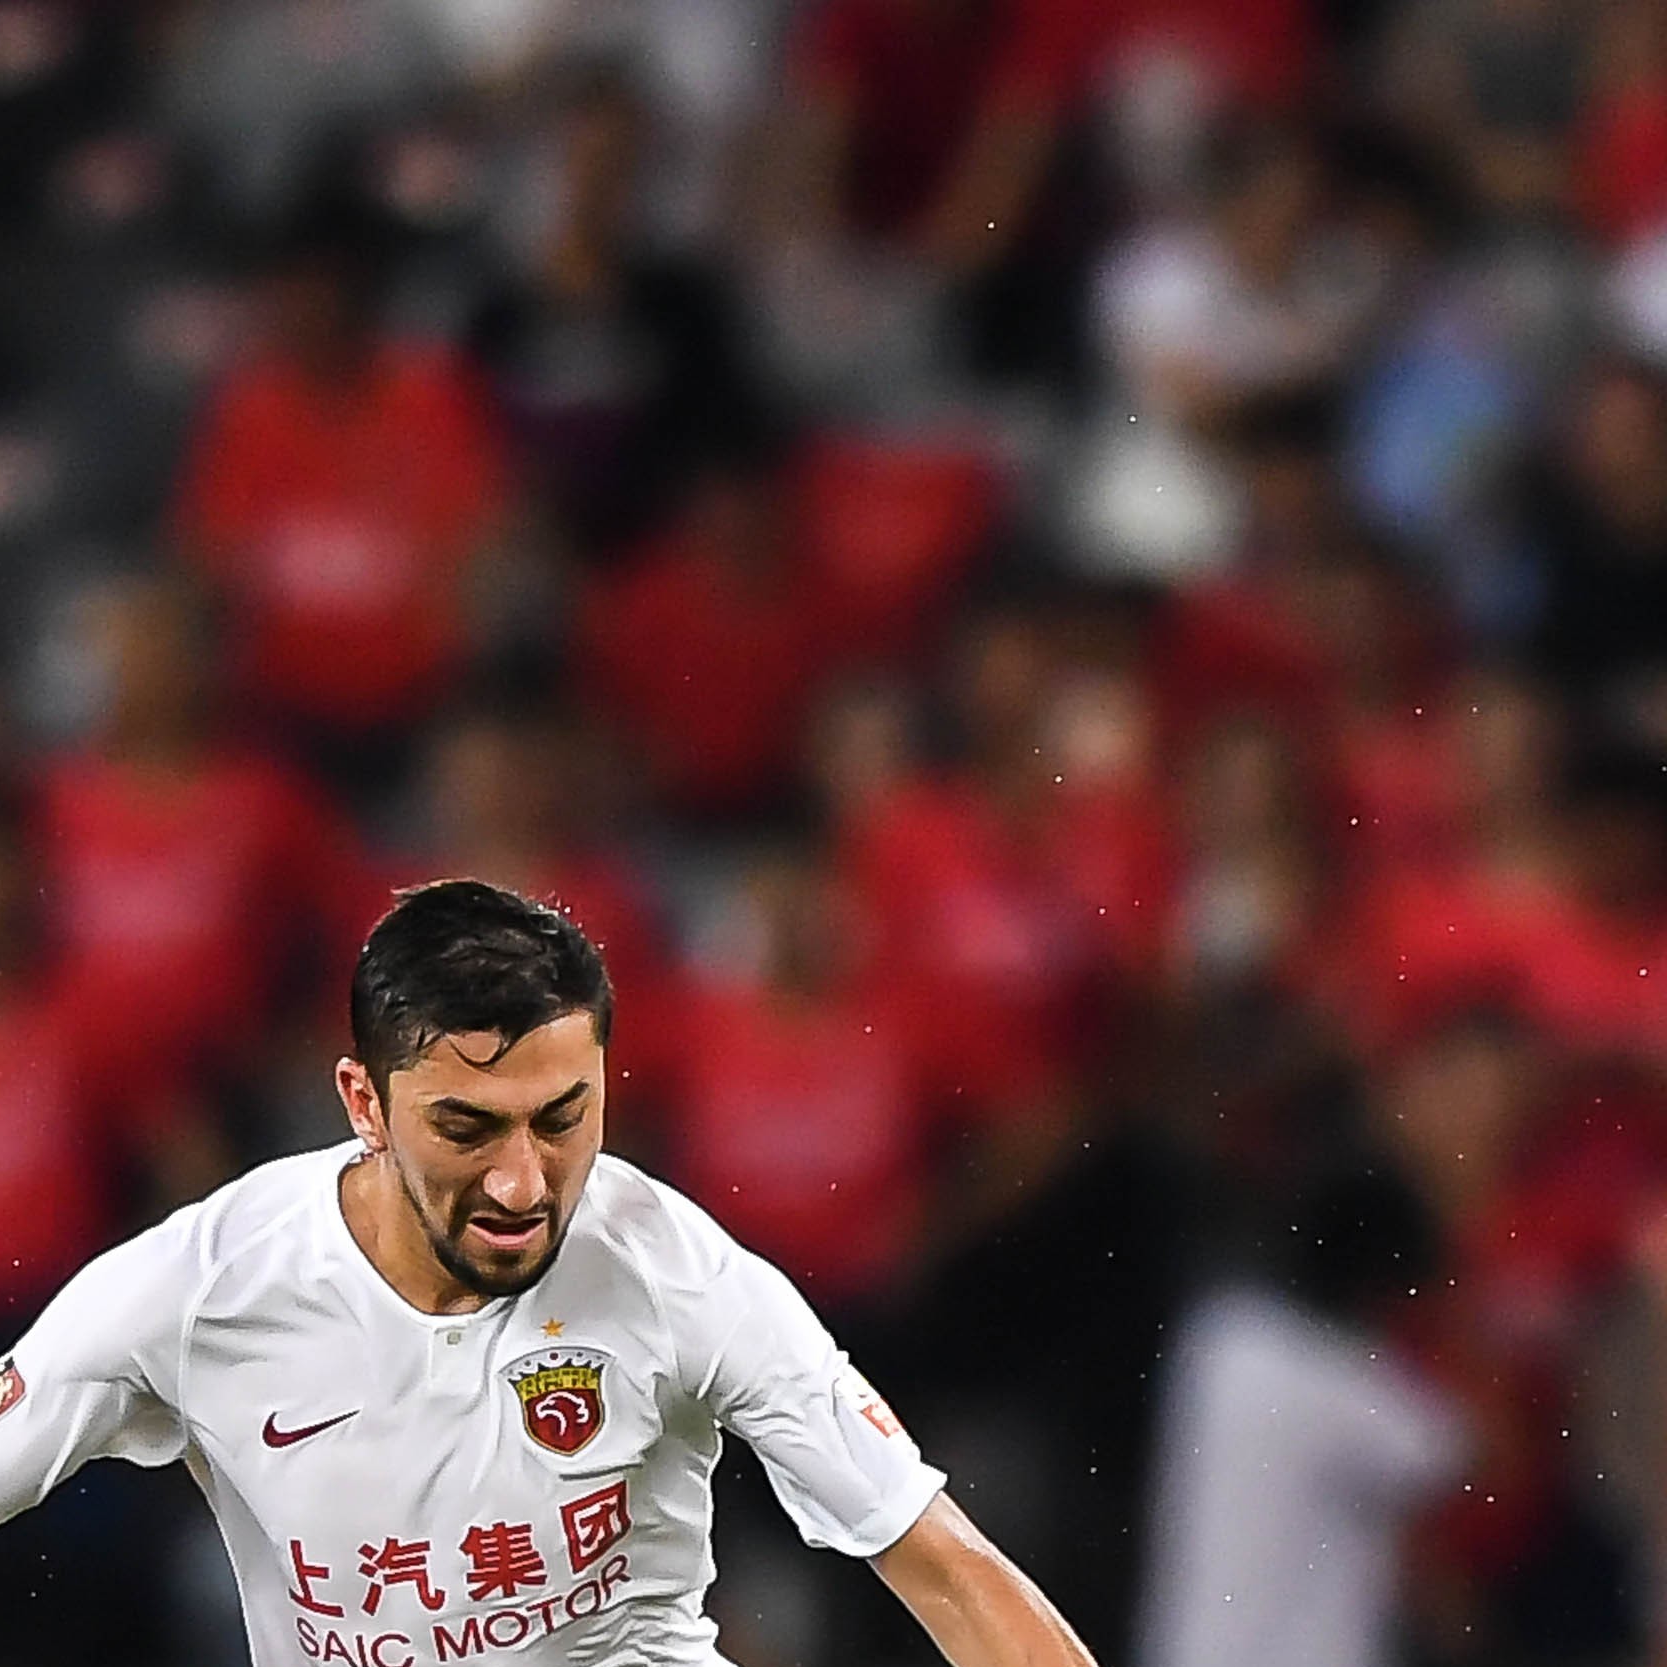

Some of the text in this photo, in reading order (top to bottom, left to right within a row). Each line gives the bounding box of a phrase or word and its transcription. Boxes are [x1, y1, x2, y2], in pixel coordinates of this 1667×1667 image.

[288, 1479, 634, 1618] 上汽集团
[431, 1554, 632, 1662] MOTOR
